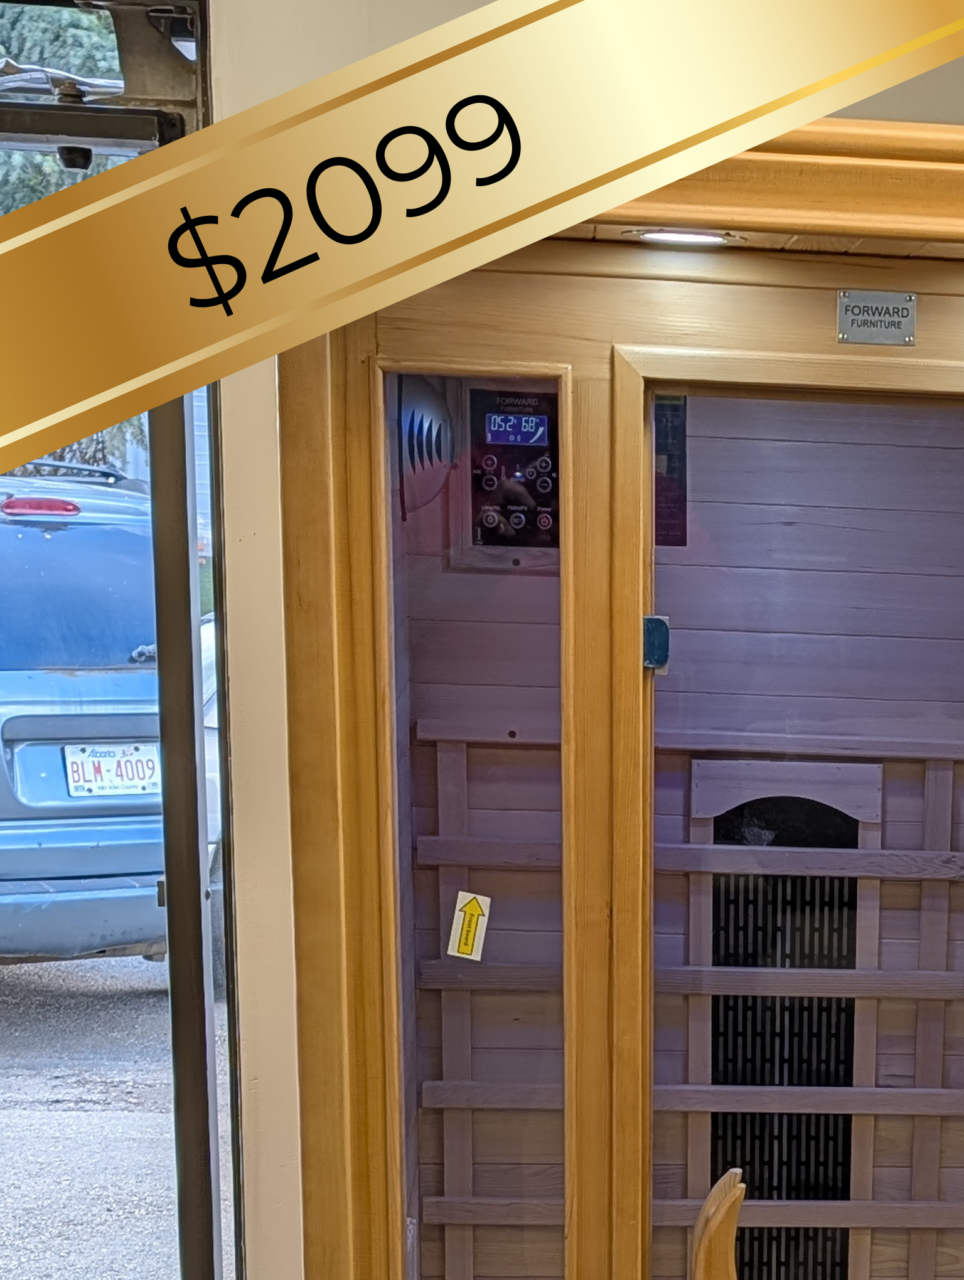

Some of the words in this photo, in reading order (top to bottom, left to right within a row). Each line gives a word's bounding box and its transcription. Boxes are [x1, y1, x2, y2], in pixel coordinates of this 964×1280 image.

[844, 305, 910, 319] FORWARD
[850, 318, 903, 330] FURNITURE
[496, 397, 539, 406] FORWARD
[70, 759, 156, 784] BLM-4009
